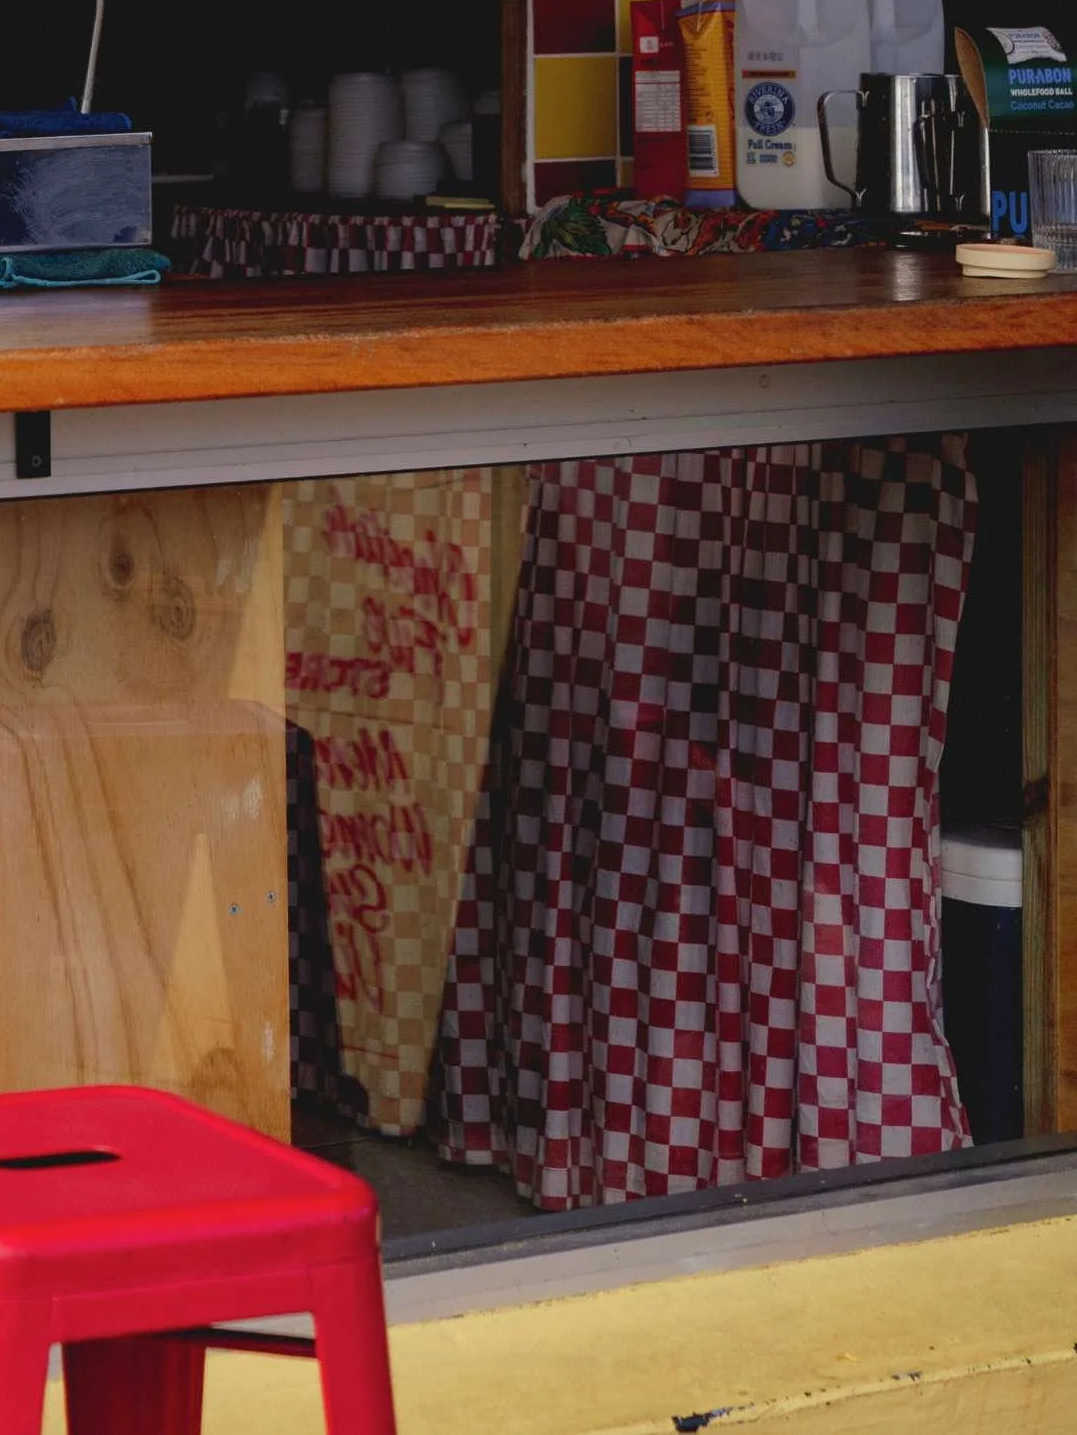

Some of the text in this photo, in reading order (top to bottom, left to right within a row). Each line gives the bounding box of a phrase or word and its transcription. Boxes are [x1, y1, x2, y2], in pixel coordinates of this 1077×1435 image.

[1009, 68, 1072, 84] PURABON
[1010, 87, 1073, 96] WHOLEFOOD BALL
[1010, 99, 1073, 111] Coconut Cacao
